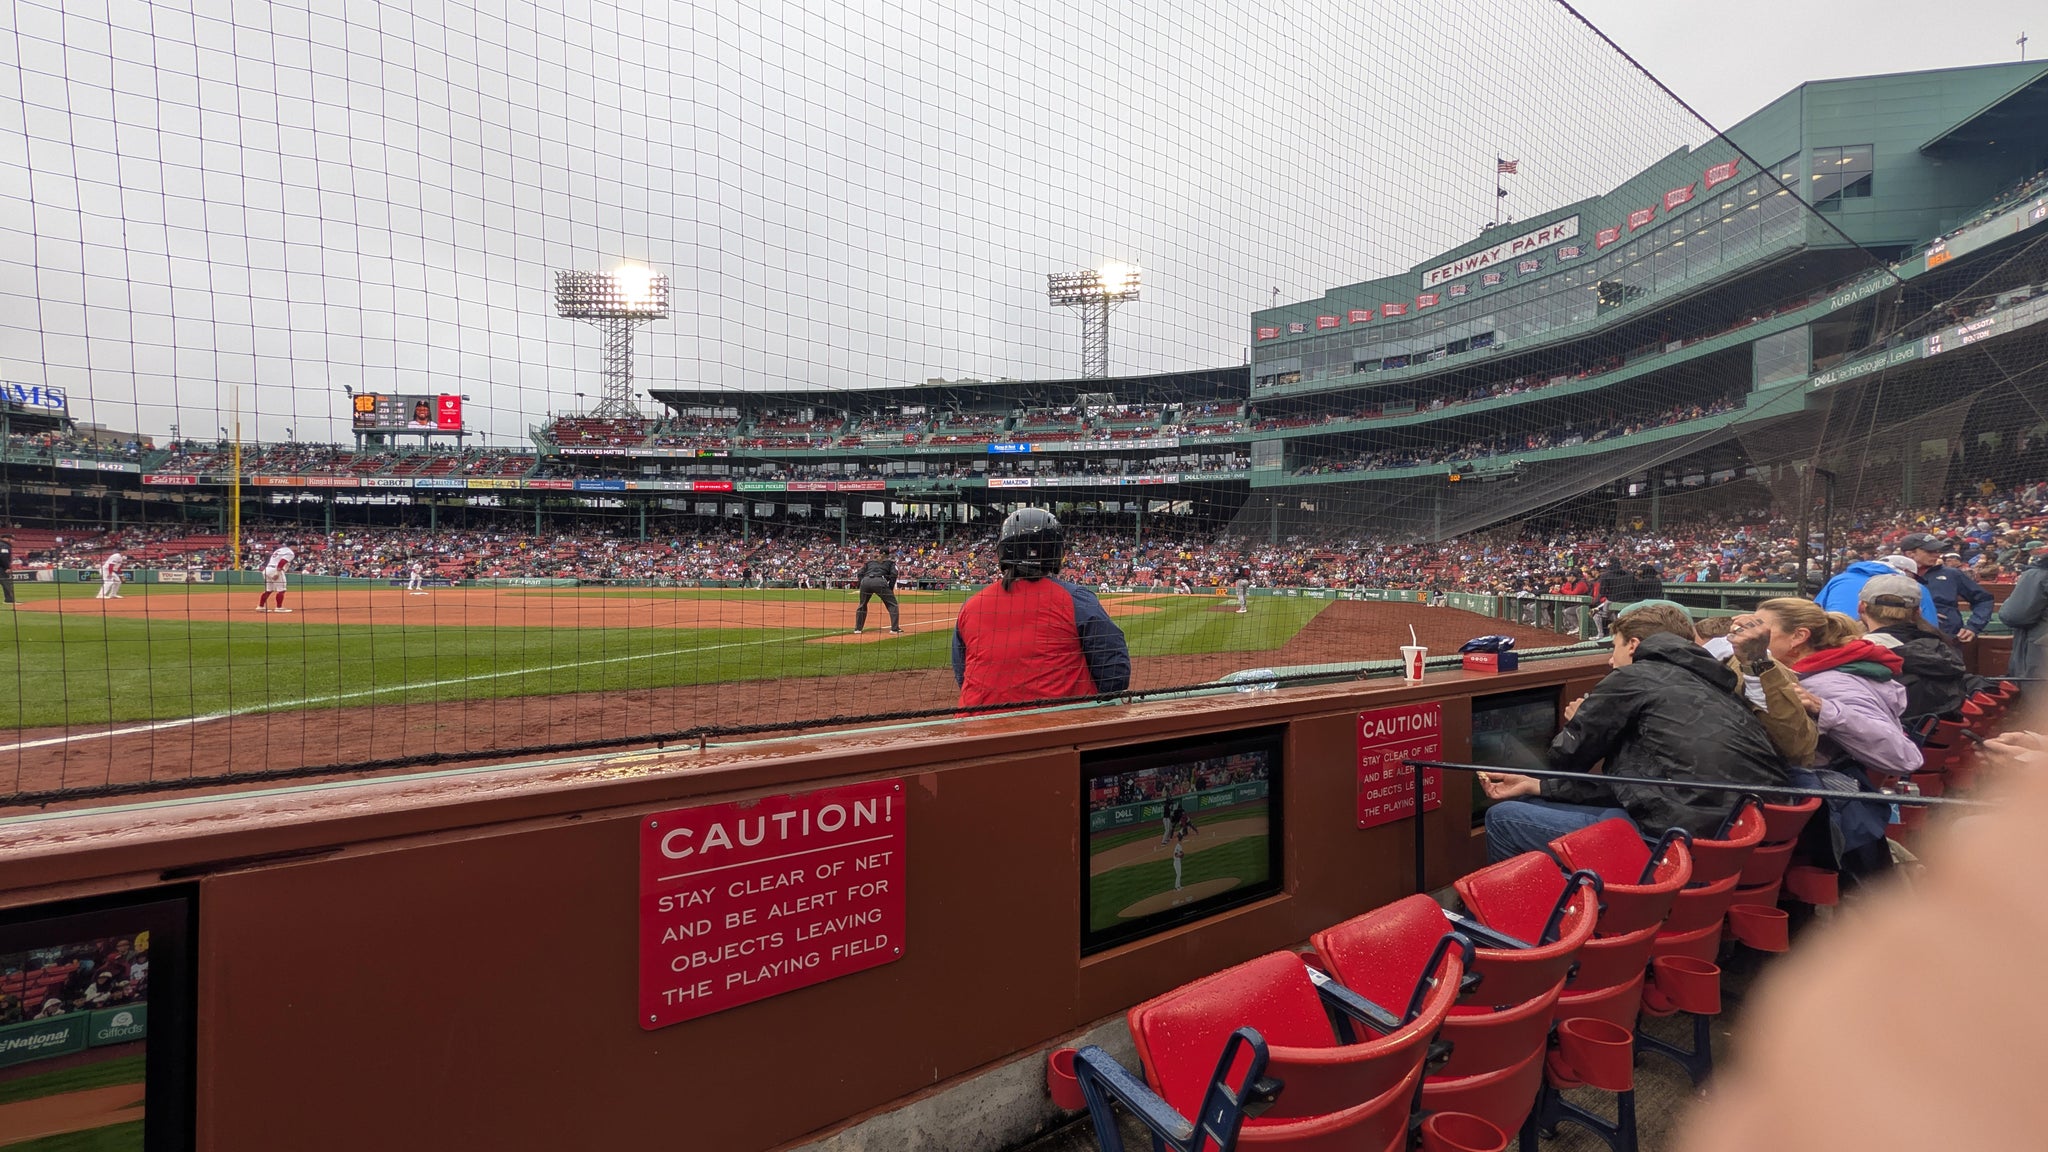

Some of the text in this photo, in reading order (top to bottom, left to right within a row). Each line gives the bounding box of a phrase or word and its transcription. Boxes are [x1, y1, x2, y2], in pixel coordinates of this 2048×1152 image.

[2035, 207, 2046, 218] 49
[1431, 248, 1500, 283] FENWAY
[1512, 224, 1565, 253] PARK
[1858, 271, 1900, 300] PAVILION
[1931, 318, 1995, 345] 17 MINNESOTA
[1930, 344, 1941, 355] 54
[1814, 347, 1914, 387] DELL Technologies Level
[1363, 711, 1437, 738] CAUTION!
[1362, 743, 1438, 767] STAY CLEAR OF NET
[1363, 765, 1416, 784] AND BE ALER
[1366, 776, 1434, 800] OBJECTS LEING
[1115, 809, 1133, 819] DELL
[1364, 791, 1437, 818] THE PLAYING ELD
[660, 796, 892, 859] CAUTION!
[658, 851, 893, 913] STAY CLEAR OF NET
[661, 879, 889, 944] AND BE ALERT FOR
[671, 908, 882, 972] OBJECTS LEAVING
[661, 934, 888, 1006] THE PLAYING FIELD
[7, 1028, 69, 1050] National
